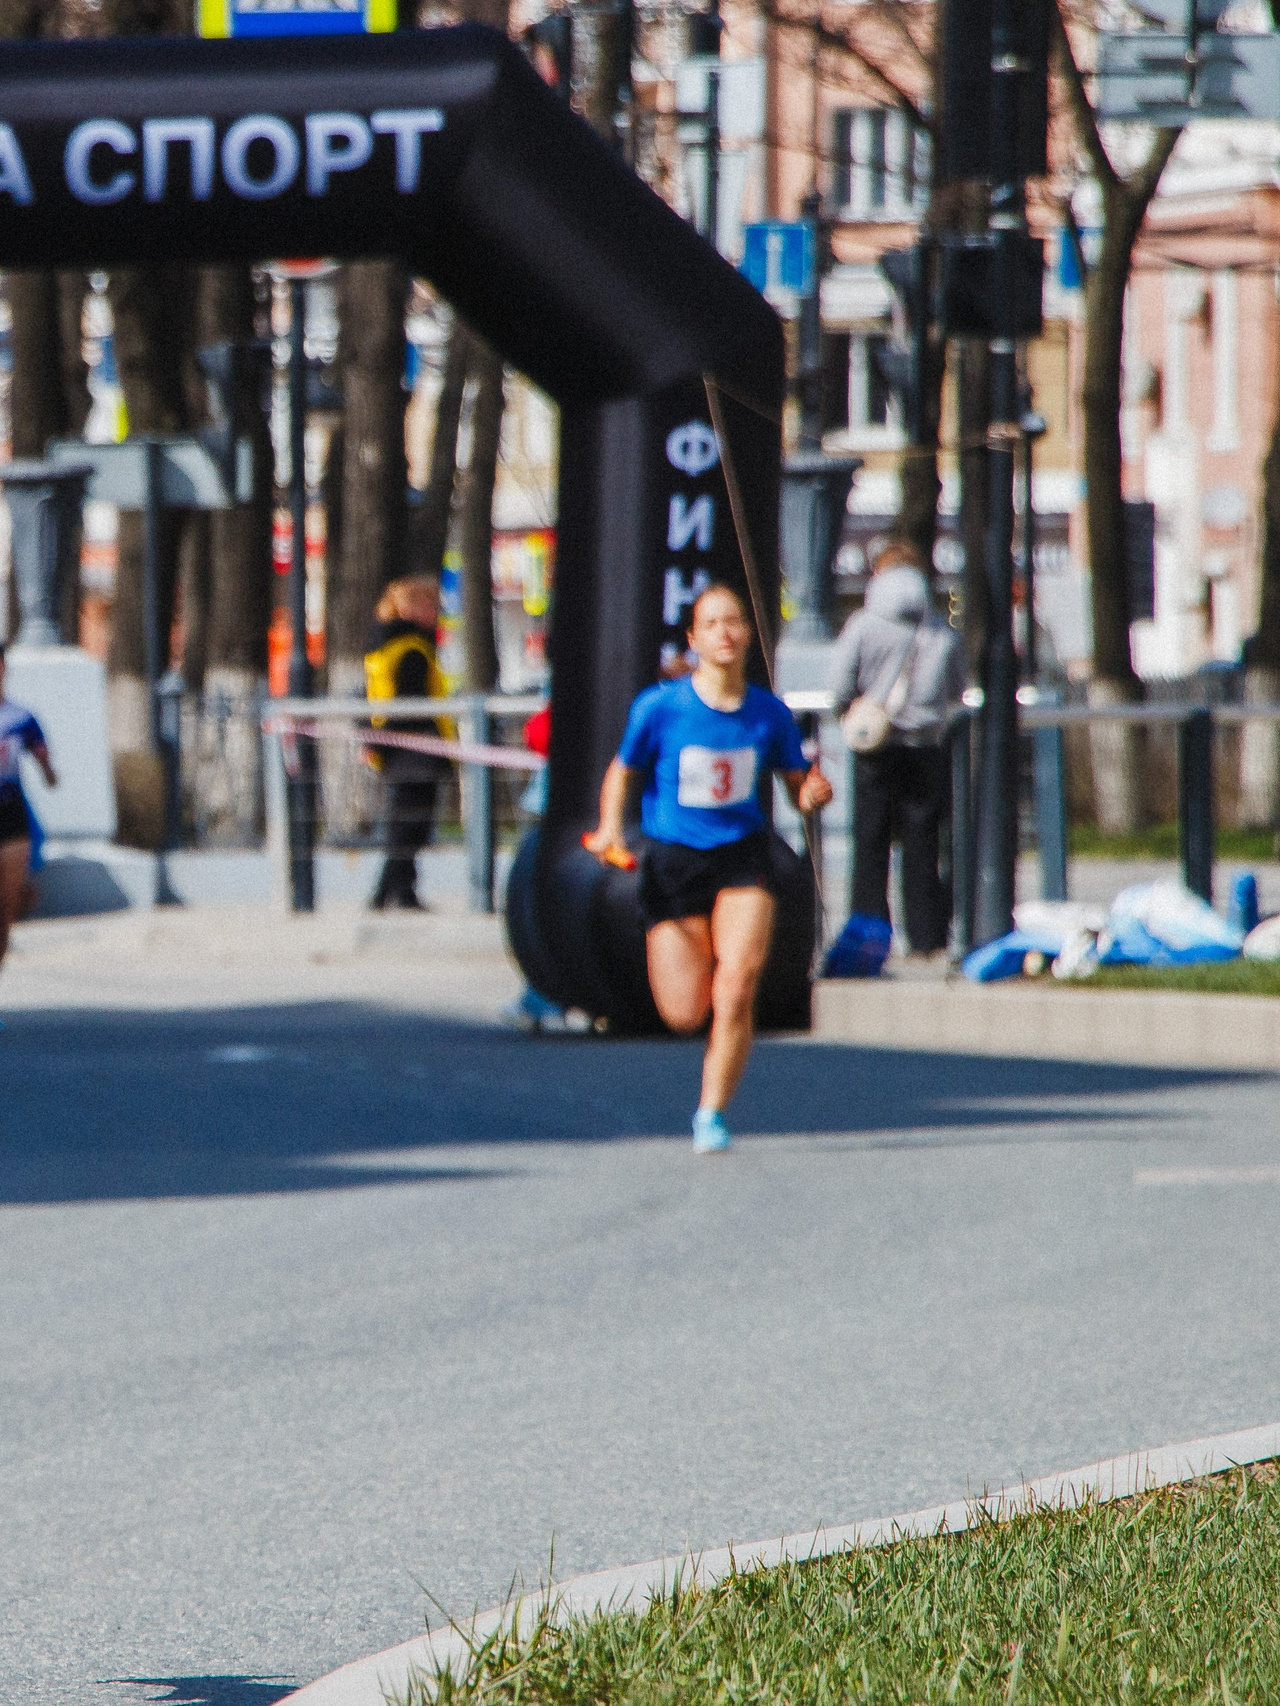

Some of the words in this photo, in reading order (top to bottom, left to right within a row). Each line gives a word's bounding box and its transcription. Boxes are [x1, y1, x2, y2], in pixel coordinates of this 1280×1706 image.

[63, 107, 445, 203] СПОРТ
[659, 418, 722, 671] ФИН
[709, 758, 733, 800] 3
